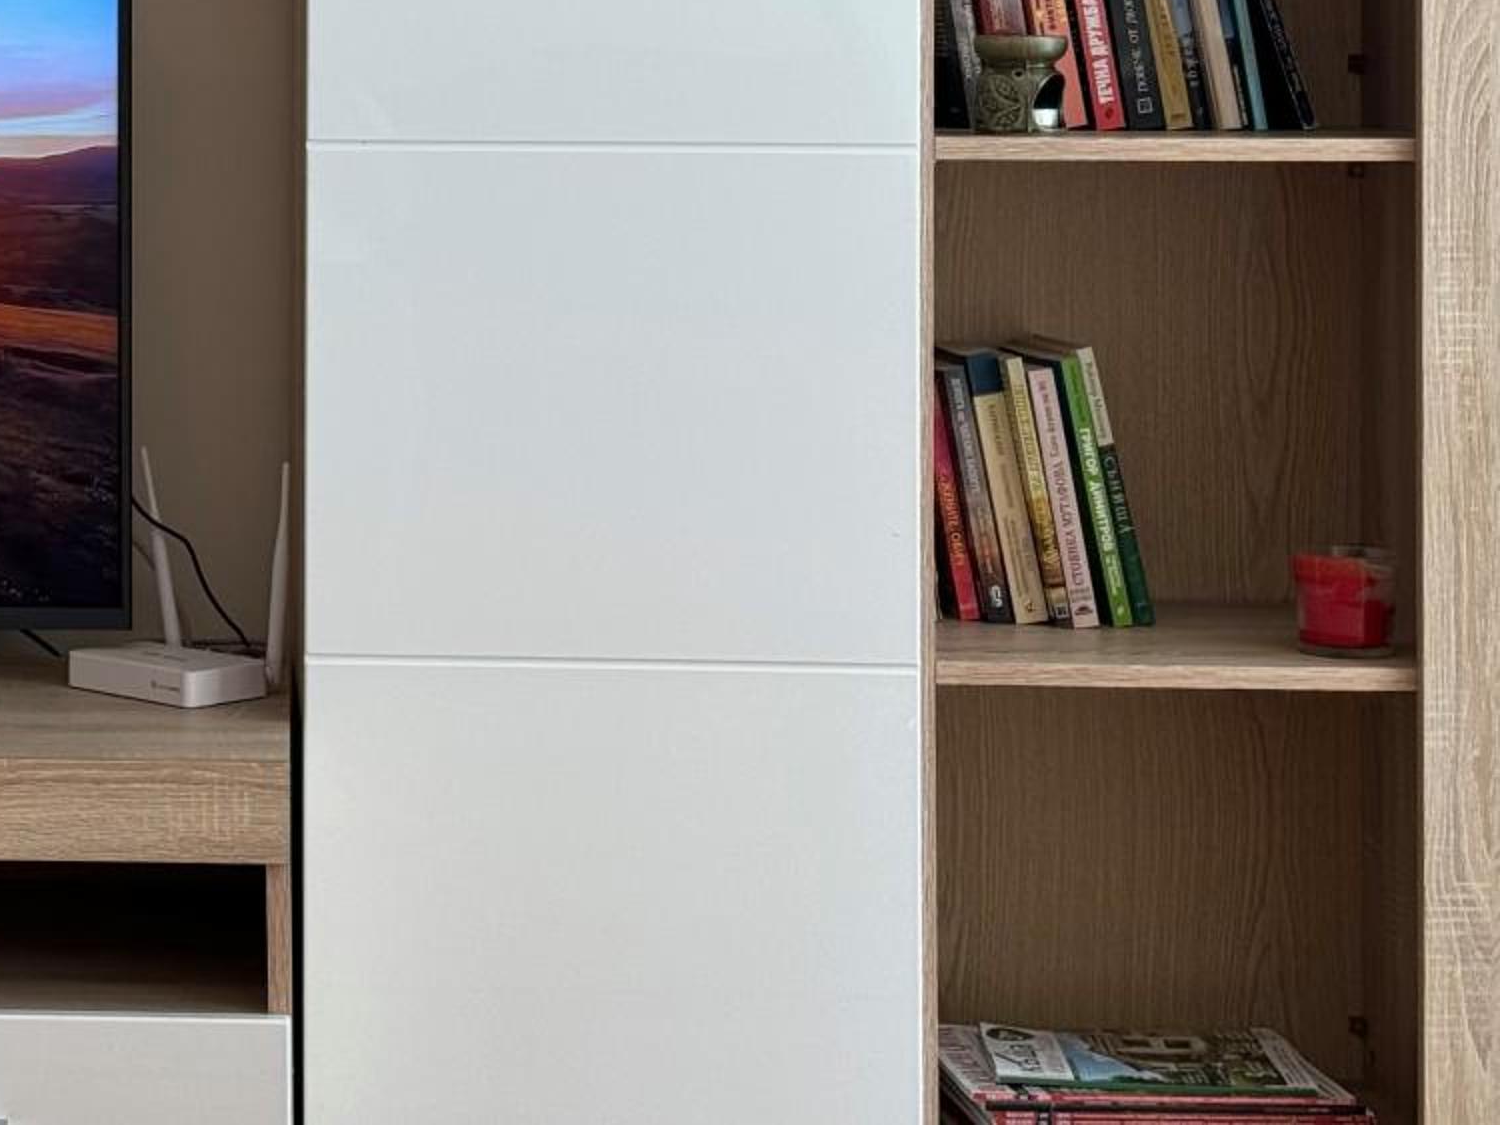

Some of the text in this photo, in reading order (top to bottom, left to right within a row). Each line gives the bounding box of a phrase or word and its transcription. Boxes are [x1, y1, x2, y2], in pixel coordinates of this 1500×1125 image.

[1094, 59, 1114, 104] ТЕЧНА
[1078, 427, 1098, 475] ГРИГОР
[1089, 480, 1113, 552] ДИМИТРОВ
